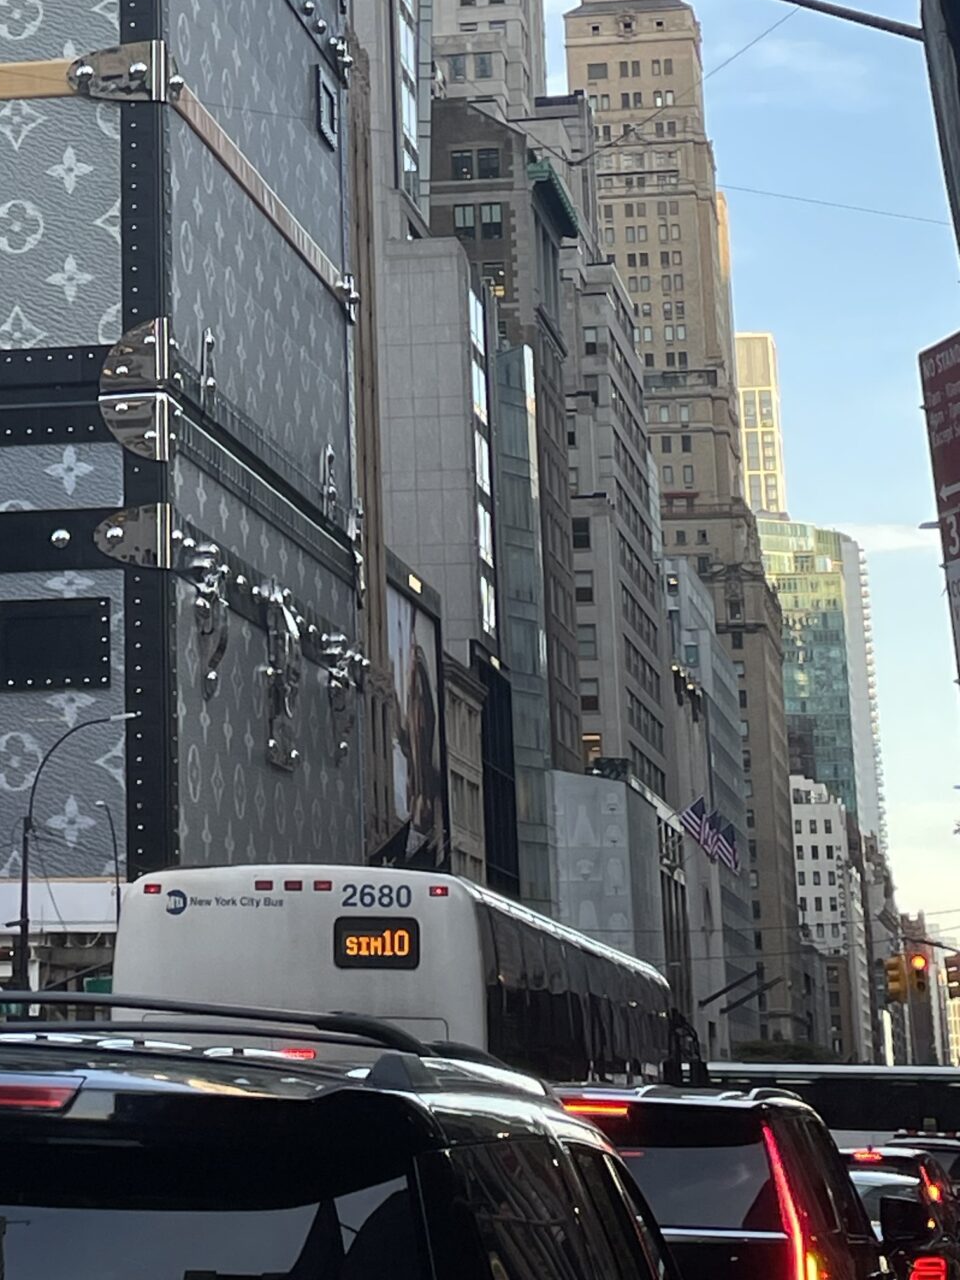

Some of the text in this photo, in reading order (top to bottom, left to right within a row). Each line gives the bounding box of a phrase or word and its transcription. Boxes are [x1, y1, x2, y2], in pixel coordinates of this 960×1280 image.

[190, 897, 212, 907] New
[215, 897, 238, 907] York
[240, 897, 261, 908] City
[265, 897, 284, 907] Bus
[342, 884, 411, 908] 2680
